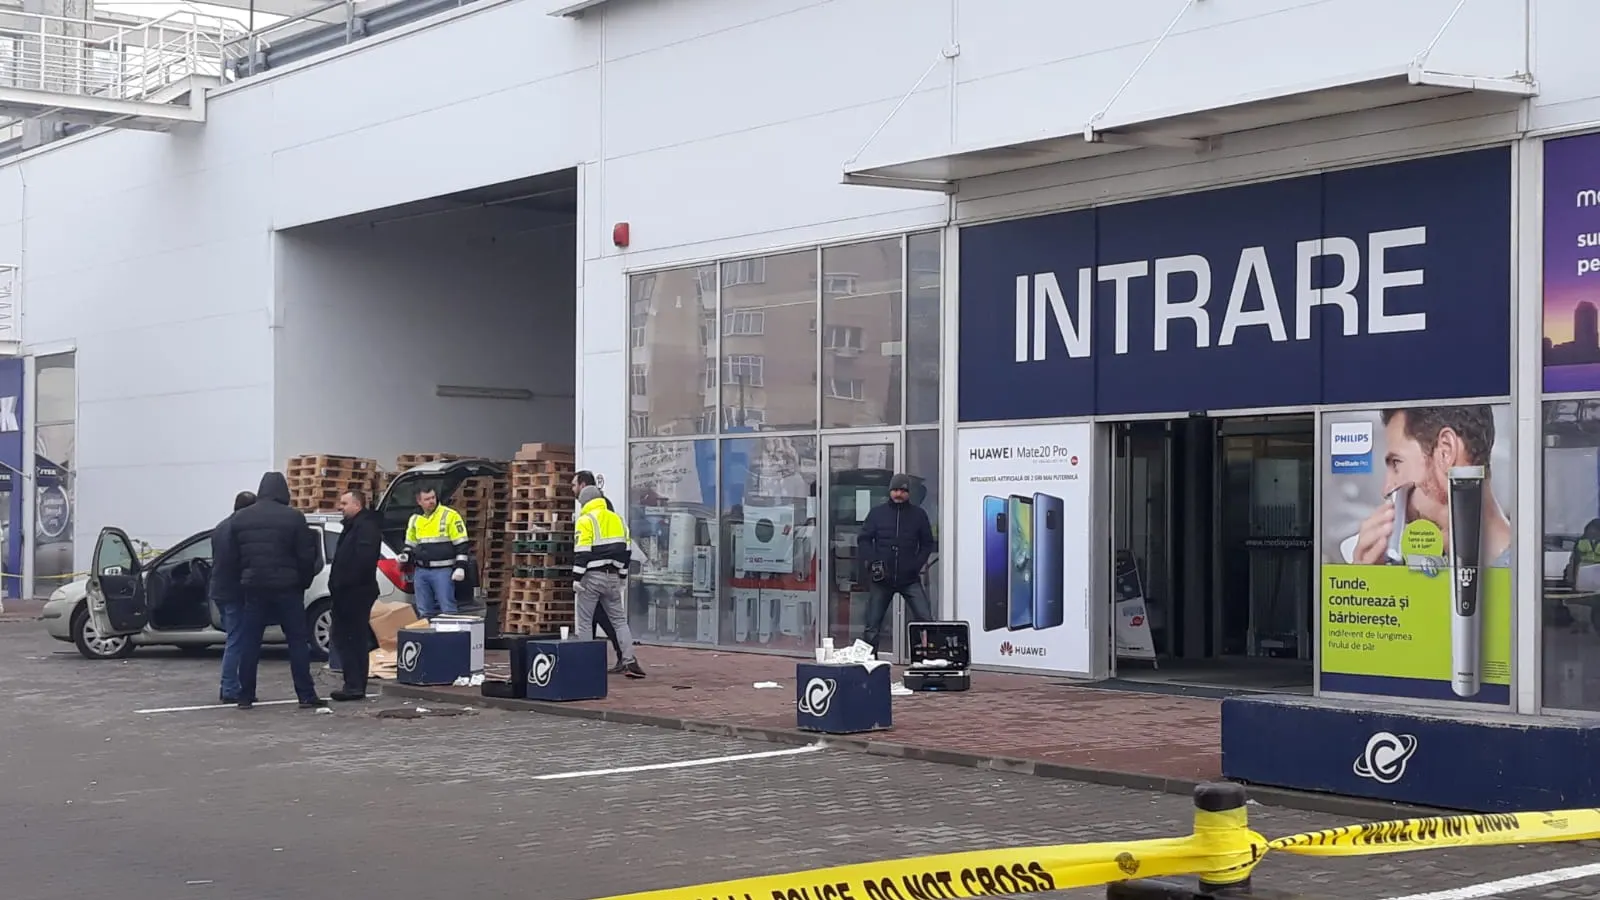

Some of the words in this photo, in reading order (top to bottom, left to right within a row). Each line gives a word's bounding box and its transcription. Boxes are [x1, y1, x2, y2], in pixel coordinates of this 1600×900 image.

[1015, 226, 1426, 362] INTRARE
[1335, 433, 1369, 443] PHILIPS
[970, 447, 1013, 460] HUAWEI
[1017, 445, 1051, 458] Mate20
[1053, 445, 1068, 457] Pro
[1329, 577, 1370, 592] Tunde,
[1329, 594, 1396, 608] conturează
[1399, 595, 1409, 611] și
[1329, 610, 1401, 628] bărbierește,
[1328, 629, 1364, 638] indiferent
[1365, 631, 1376, 639] de
[1376, 632, 1413, 641] lungimea
[1014, 646, 1047, 657] HUAWEI
[1351, 642, 1361, 650] de
[902, 871, 960, 900] NOT
[960, 861, 1056, 898] CROSS
